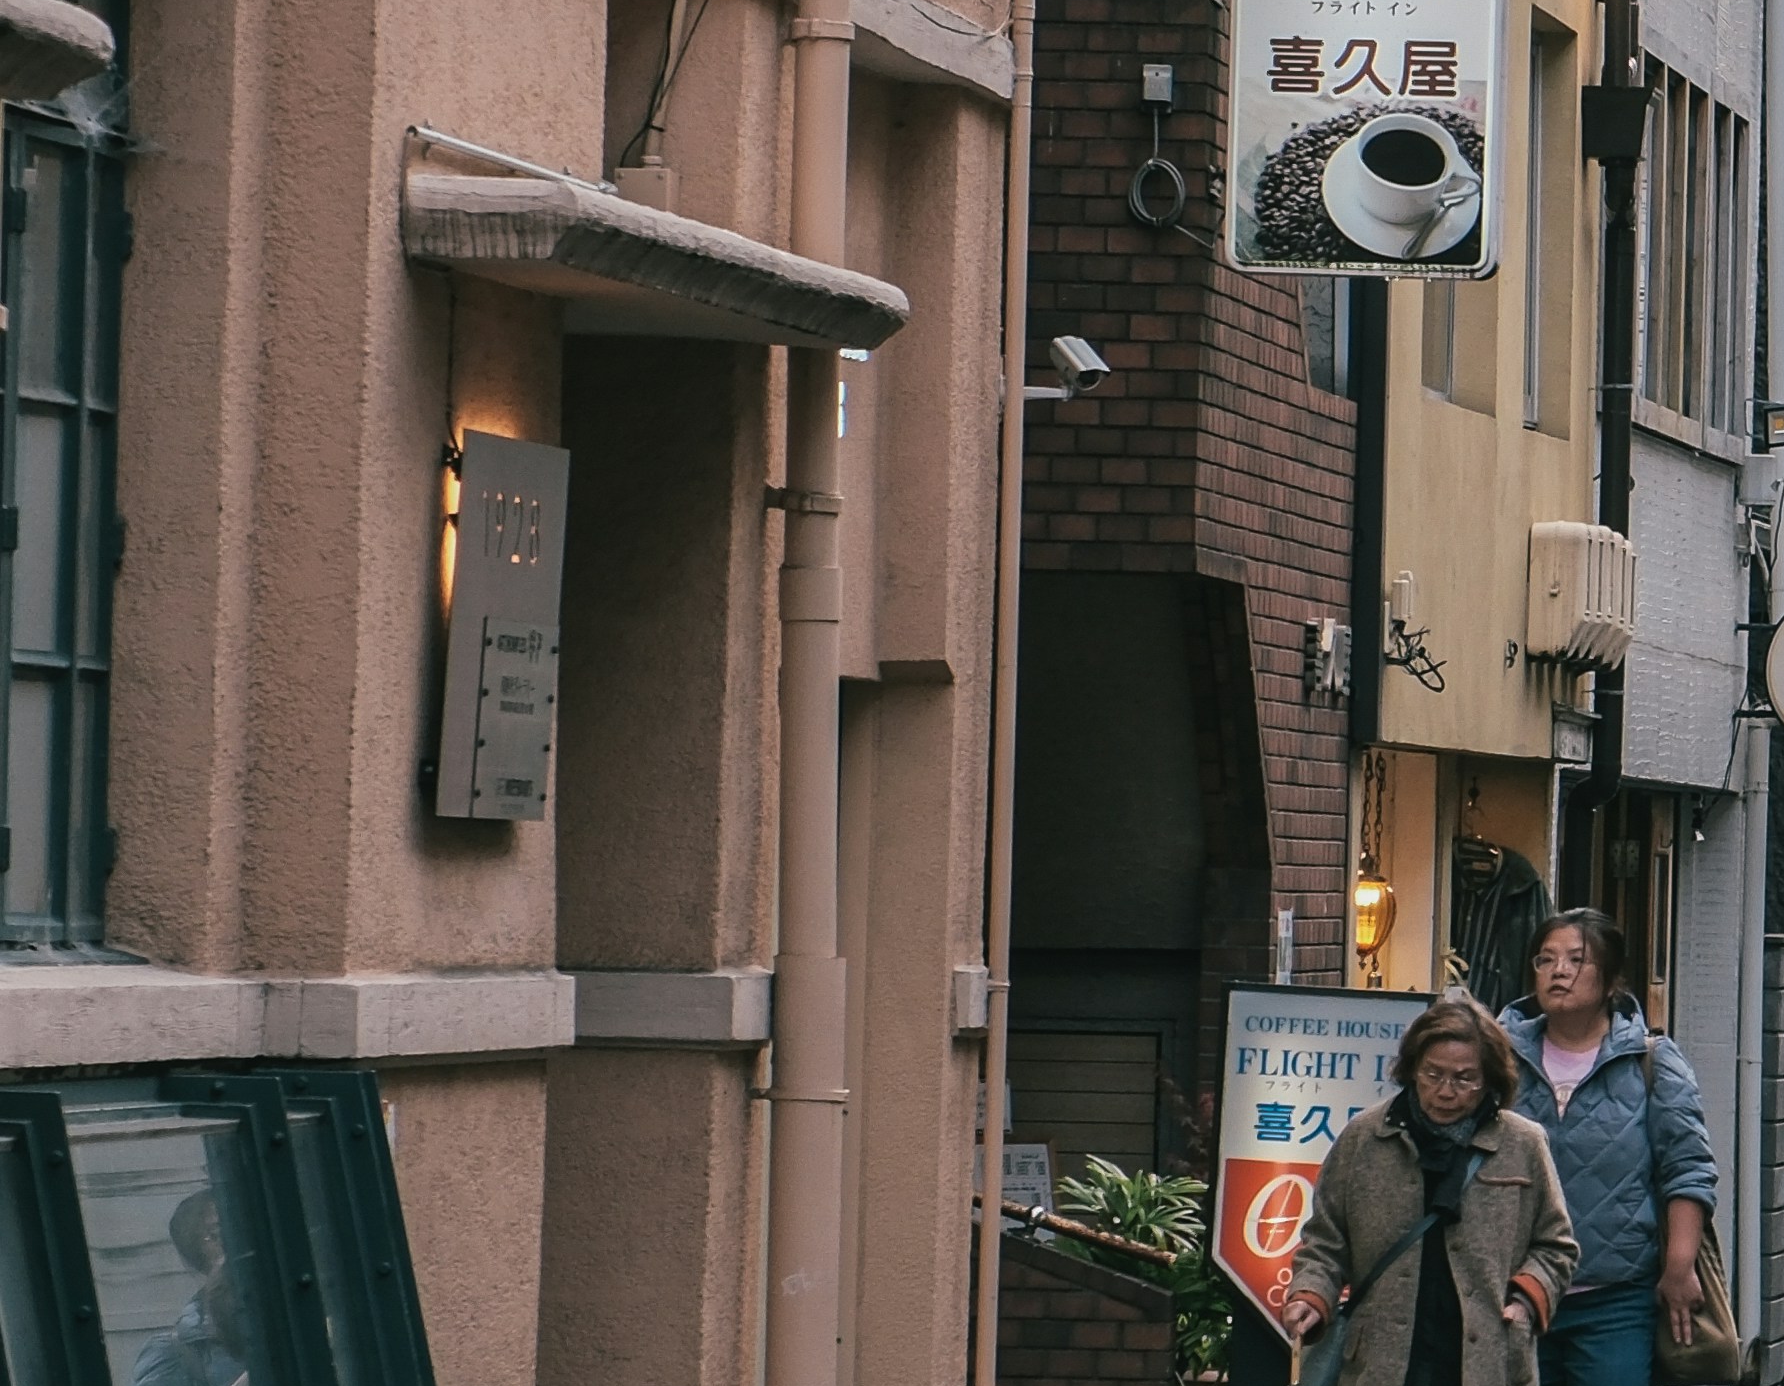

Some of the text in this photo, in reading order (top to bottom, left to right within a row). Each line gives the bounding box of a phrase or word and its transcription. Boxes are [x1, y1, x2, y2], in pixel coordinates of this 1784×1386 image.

[1311, 0, 1418, 16] フライト イン
[1266, 35, 1459, 97] 喜久屋
[1245, 1015, 1330, 1036] COFFEE
[1235, 1047, 1361, 1080] FLIGHT
[1266, 1081, 1323, 1094] フライト
[1254, 1101, 1364, 1144] 喜久
